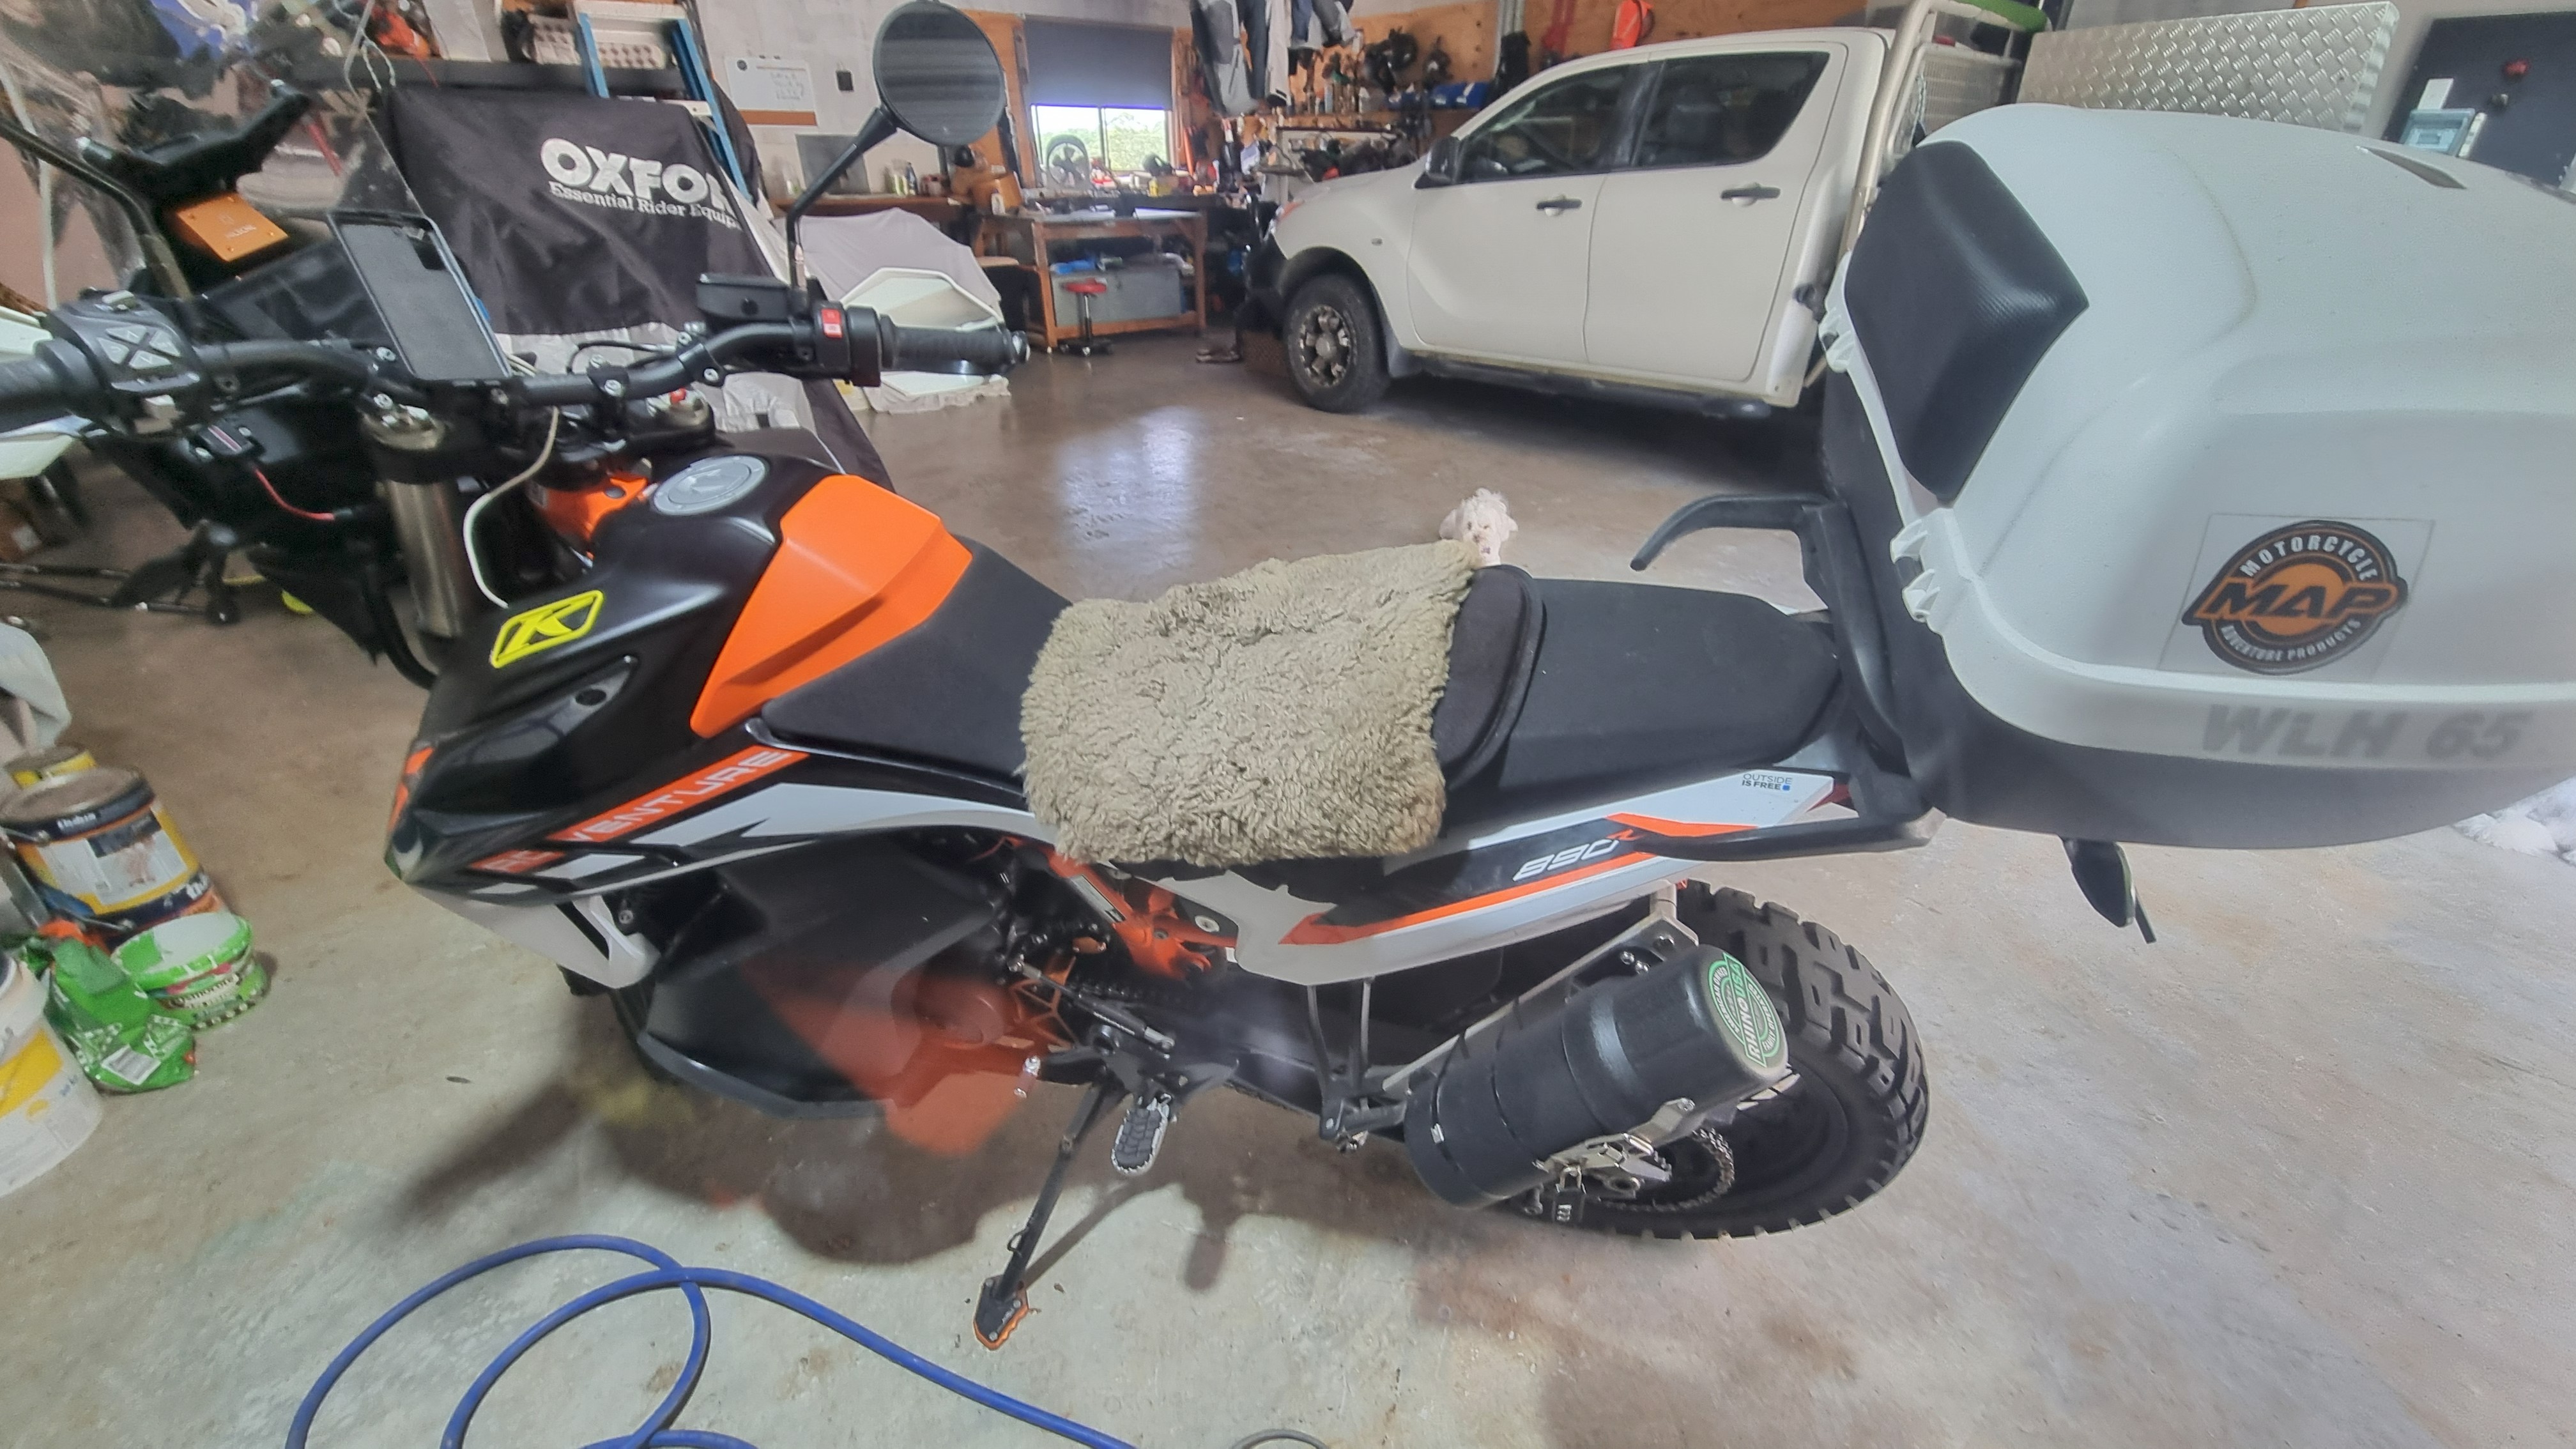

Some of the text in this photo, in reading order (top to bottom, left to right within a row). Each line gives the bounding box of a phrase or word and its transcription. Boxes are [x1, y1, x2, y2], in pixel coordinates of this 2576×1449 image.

[549, 181, 742, 229] Essential Rider Equip
[2239, 535, 2378, 581] MOTORCYCLE
[2205, 582, 2393, 618] MAP
[2220, 618, 2361, 661] ADVENTURE PRODUCTS
[2203, 703, 2534, 760] WLH 65
[1743, 773, 1793, 785] OUTSIDE
[1753, 781, 1781, 790] FREE
[1713, 984, 1740, 1034] AMERICAN
[1736, 997, 1761, 1060] RHINO
[1761, 1031, 1776, 1052] FAMILY
